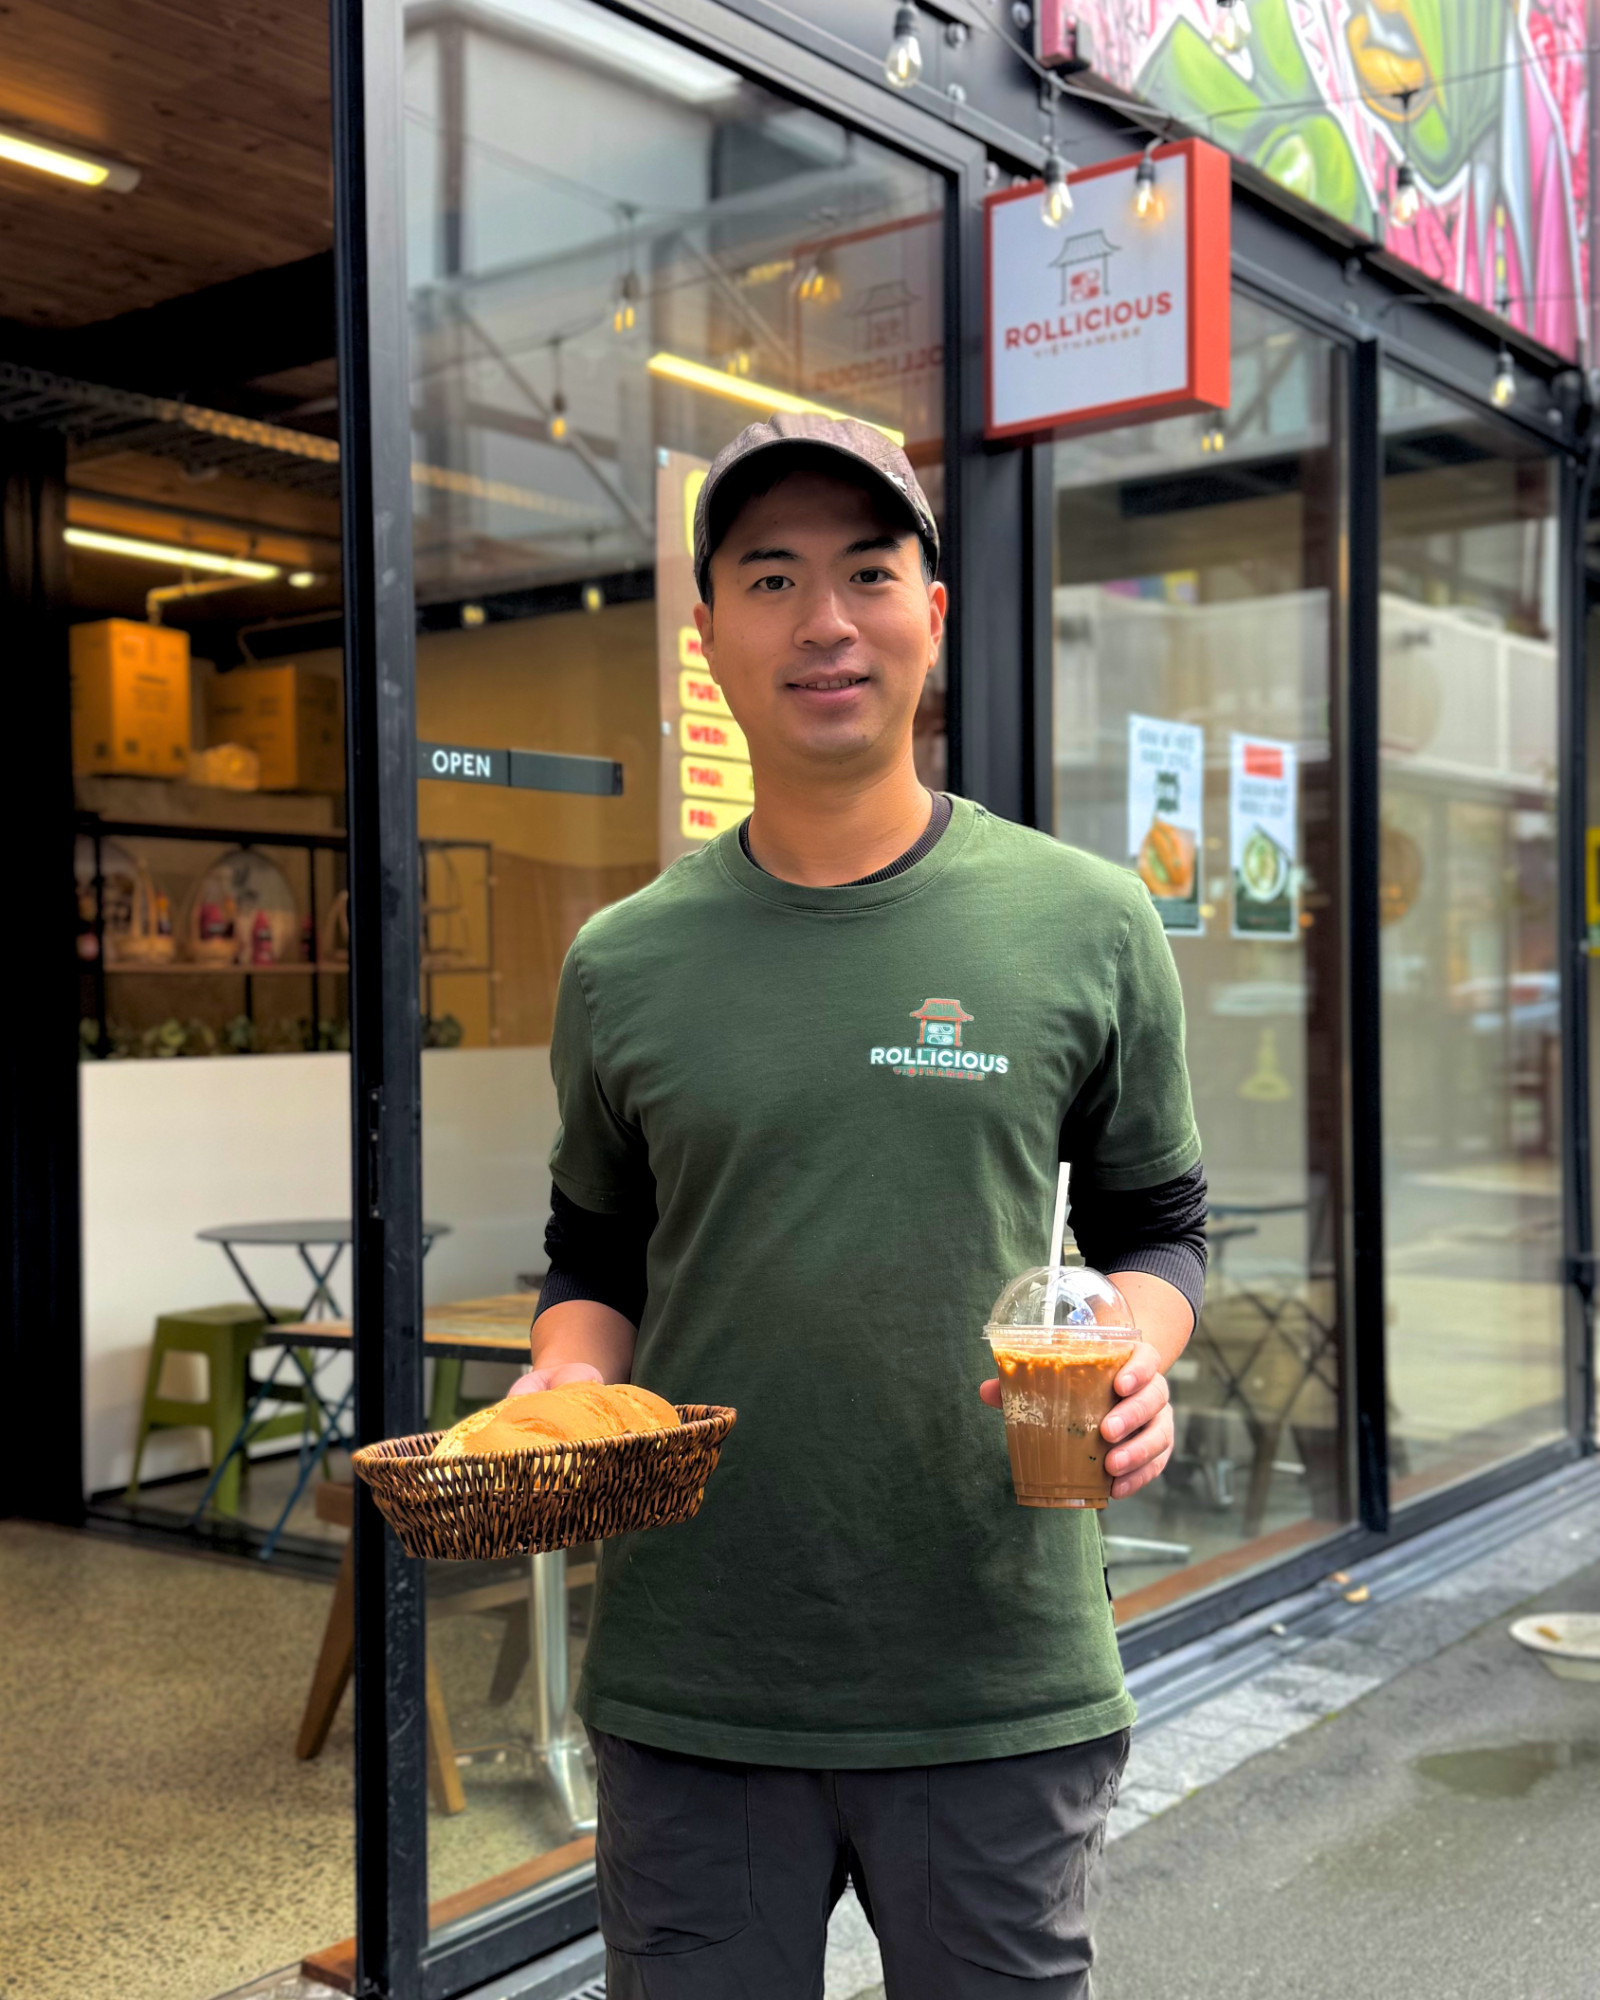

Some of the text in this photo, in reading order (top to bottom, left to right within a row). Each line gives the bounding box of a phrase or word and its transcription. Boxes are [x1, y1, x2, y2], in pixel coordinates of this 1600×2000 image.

[1005, 291, 1173, 350] ROLLICIOUS
[432, 750, 491, 777] OPEN
[869, 1046, 1009, 1074] ROLLICIOUS
